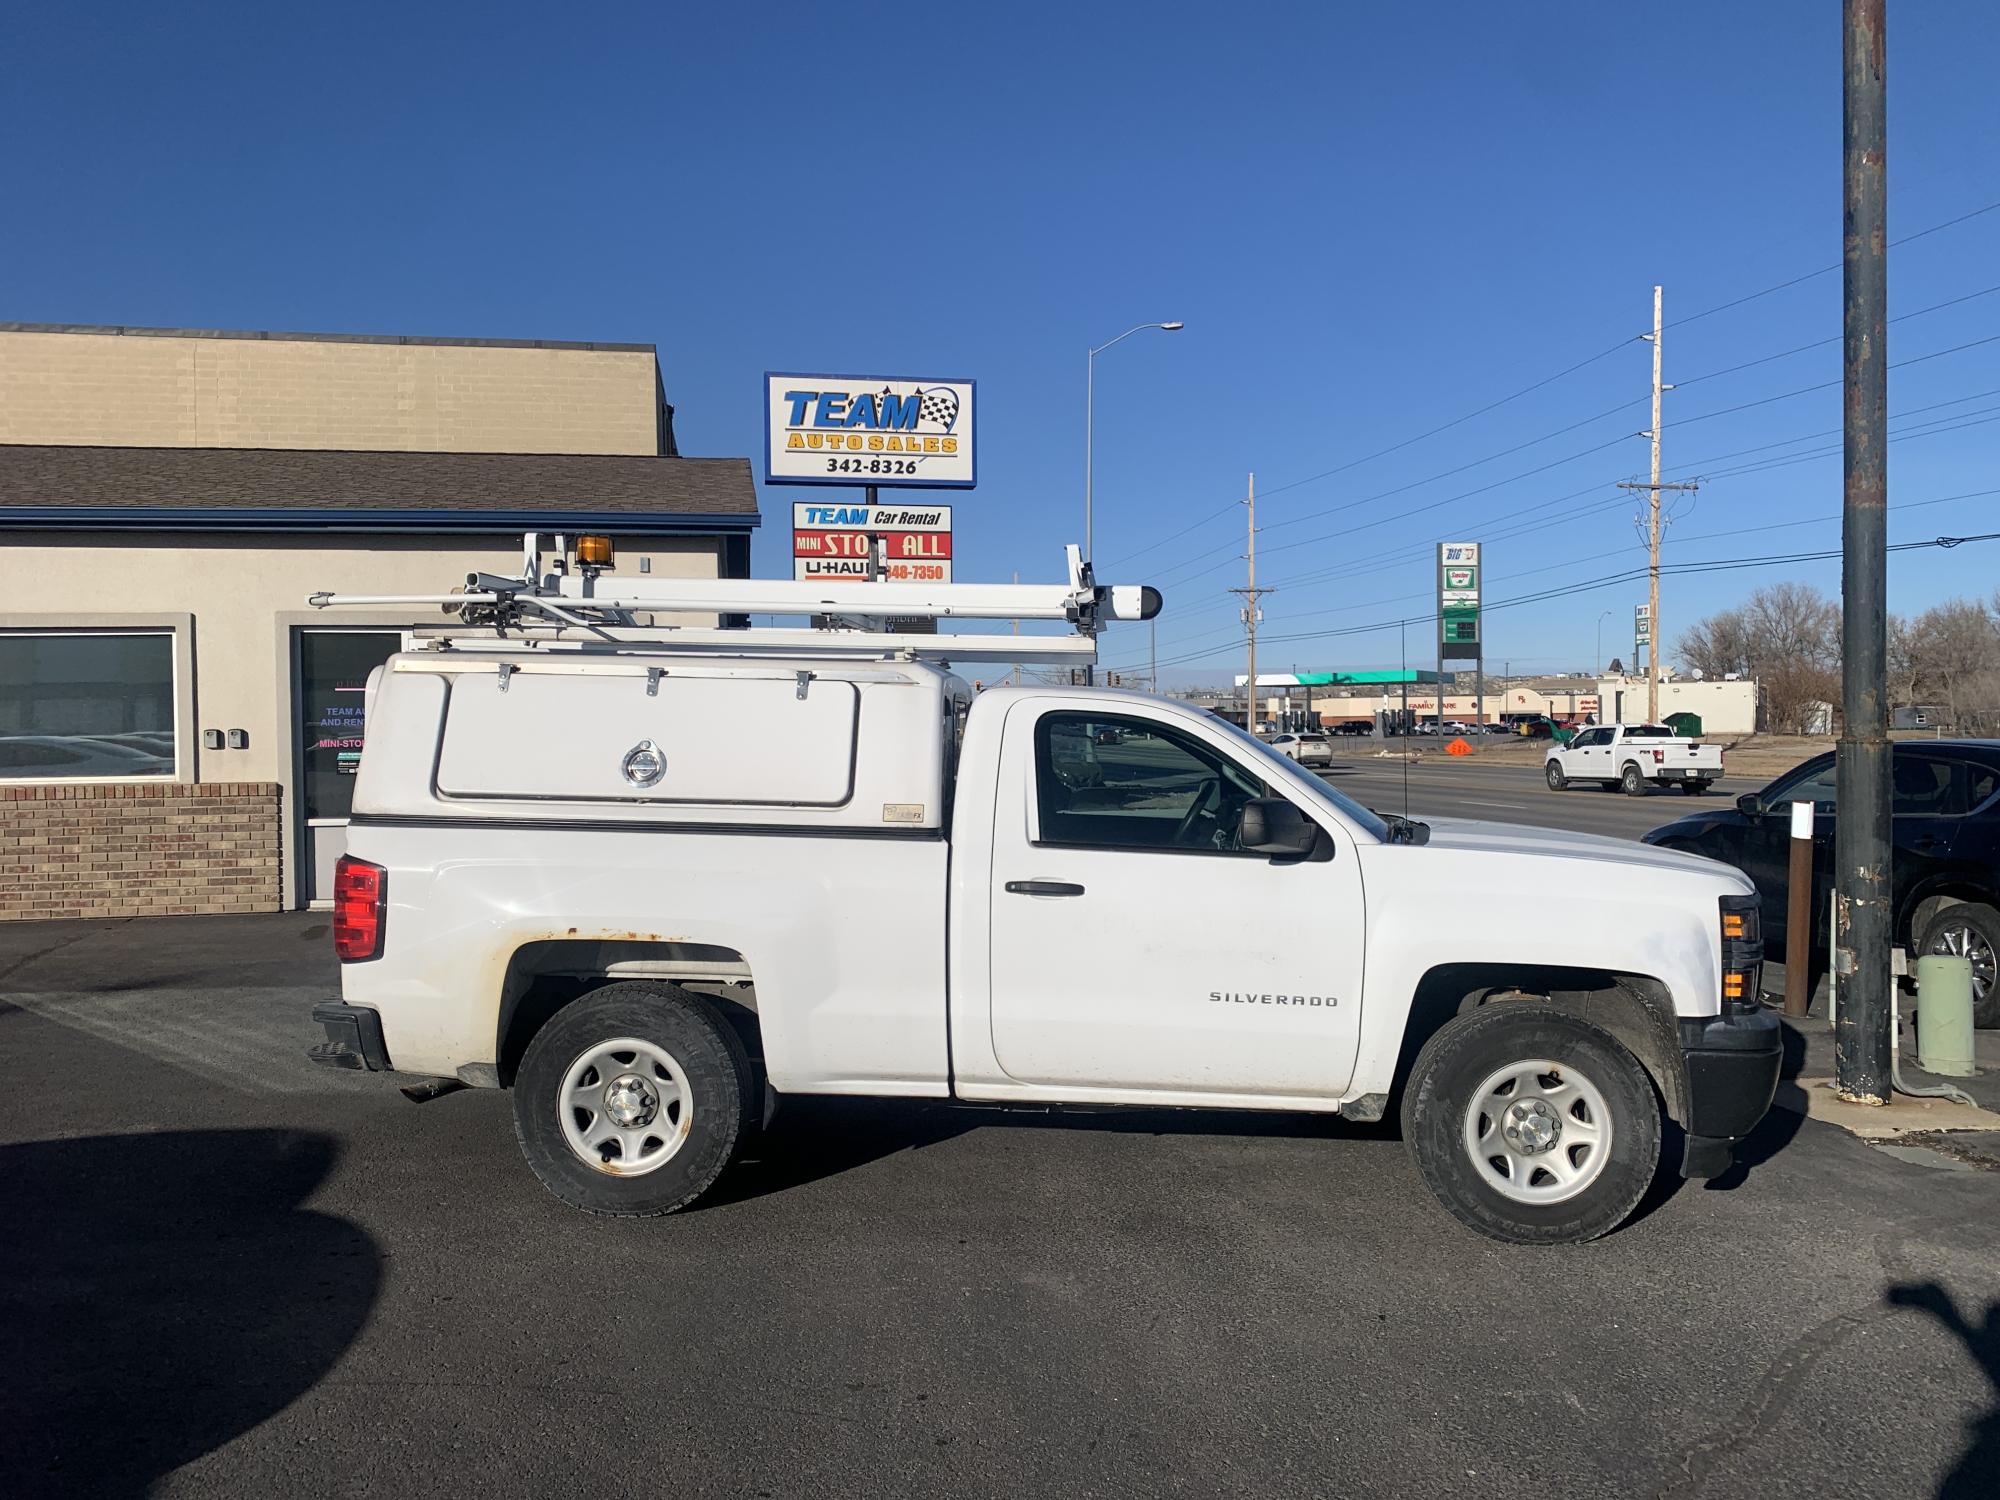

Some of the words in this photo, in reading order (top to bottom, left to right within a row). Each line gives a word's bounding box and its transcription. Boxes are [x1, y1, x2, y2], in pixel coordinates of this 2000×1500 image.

[784, 391, 923, 430] TEAM
[787, 433, 863, 450] AUTO
[868, 435, 958, 453] SALES
[826, 458, 917, 474] 342-8326
[805, 508, 869, 525] TEAM
[874, 511, 899, 524] Car
[898, 511, 941, 525] Rental
[796, 537, 821, 550] MINI
[824, 534, 869, 556] STO
[902, 535, 946, 556] ALL
[326, 707, 353, 716] TEAM
[1408, 701, 1434, 709] FAMILY
[1209, 991, 1338, 1007] SILVERADO
